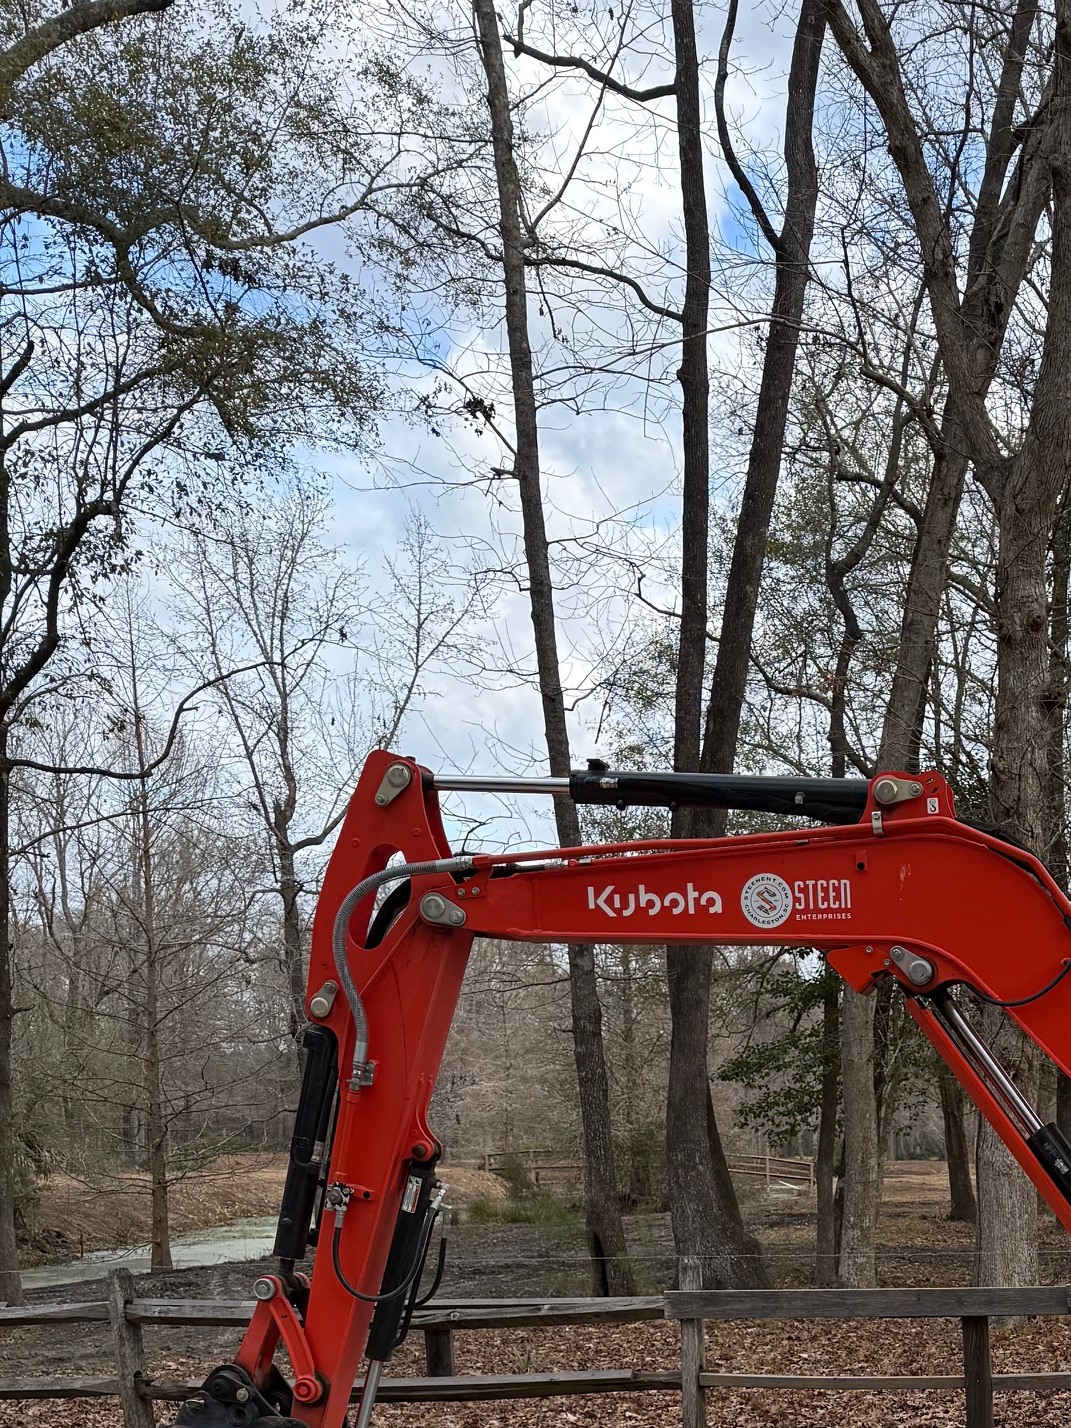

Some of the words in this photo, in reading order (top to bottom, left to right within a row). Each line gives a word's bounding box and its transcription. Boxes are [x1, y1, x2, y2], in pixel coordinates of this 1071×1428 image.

[587, 882, 723, 918] Kubota
[744, 876, 789, 900] STEENENT.COM
[794, 879, 852, 909] STEEN
[796, 912, 852, 921] ENTERPRISES
